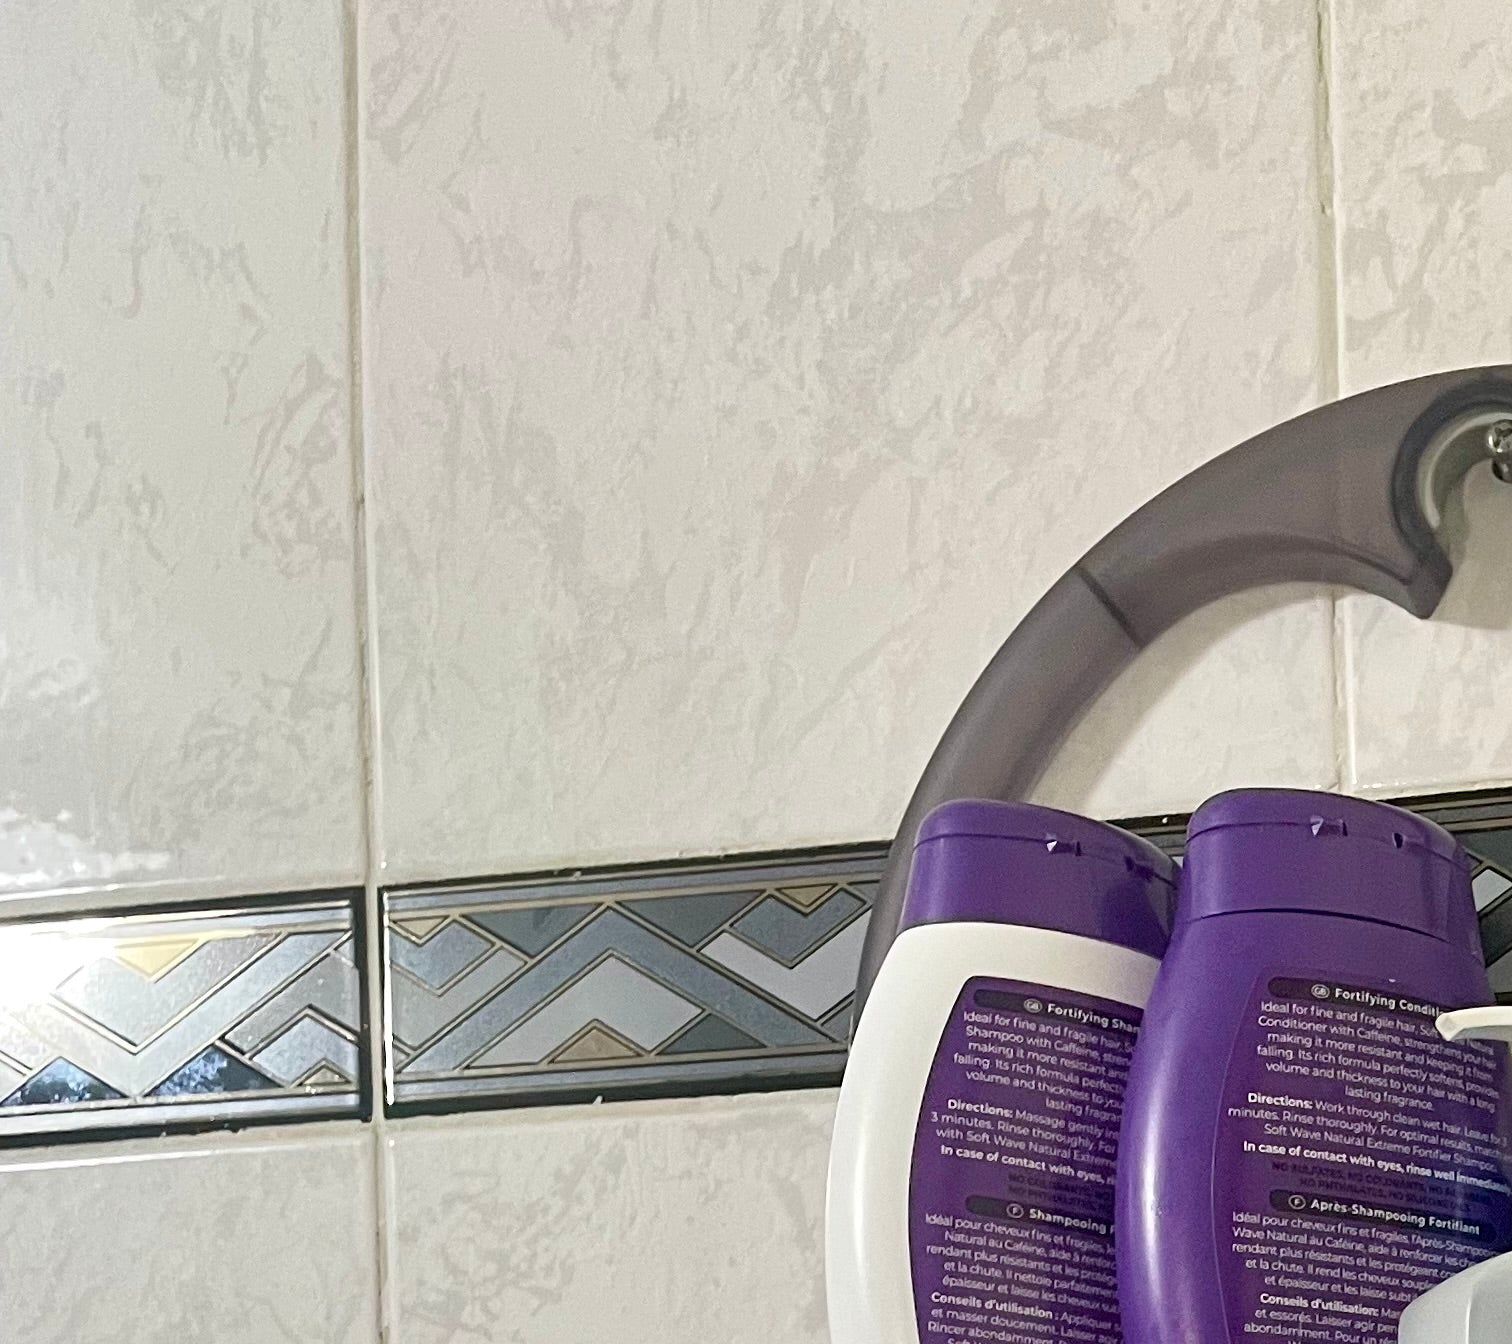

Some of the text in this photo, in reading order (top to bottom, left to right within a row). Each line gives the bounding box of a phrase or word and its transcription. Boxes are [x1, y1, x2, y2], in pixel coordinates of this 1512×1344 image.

[1334, 987, 1396, 1010] Fortifying
[964, 1011, 1060, 1035] Ideal for fine and
[1047, 1002, 1109, 1029] Fortifying
[1261, 1001, 1289, 1013] Ideal
[1292, 1004, 1308, 1016] for
[1311, 1007, 1334, 1018] fine
[1336, 1011, 1358, 1021] and
[966, 1026, 1052, 1048] Shampoo with
[1258, 1016, 1354, 1036] Conditioner with
[1267, 1034, 1313, 1049] making
[1325, 1041, 1356, 1051] more
[1404, 1053, 1424, 1063] and
[1298, 1049, 1380, 1070] Its rich formula
[1266, 1062, 1310, 1075] volume
[1312, 1068, 1334, 1078] and
[1390, 1078, 1401, 1089] to
[1402, 1083, 1424, 1093] your
[1344, 1085, 1380, 1103] lasting
[947, 1099, 1066, 1130] Directions: Massage
[1247, 1092, 1391, 1122] Directions: Work through
[930, 1112, 938, 1122] 3
[998, 1121, 1030, 1136] Rinse
[1264, 1124, 1364, 1146] Soft Wave Natural
[1282, 1111, 1398, 1136] Rinse For
[940, 1144, 953, 1155] In
[956, 1149, 984, 1160] case
[986, 1152, 999, 1162] of
[1001, 1156, 1046, 1171] contact
[1048, 1164, 1075, 1176] with
[1243, 1141, 1455, 1180] In case of contact with eyes, rinse well
[1029, 1209, 1106, 1235] Shampooing
[1310, 1198, 1480, 1234] Après-Shampooing Fortifiant
[931, 1291, 1053, 1319] Conseils d'utilisation
[1260, 1293, 1309, 1307] Conseils
[927, 1321, 966, 1335] Rincer
[1335, 1331, 1376, 1344] Pour un
